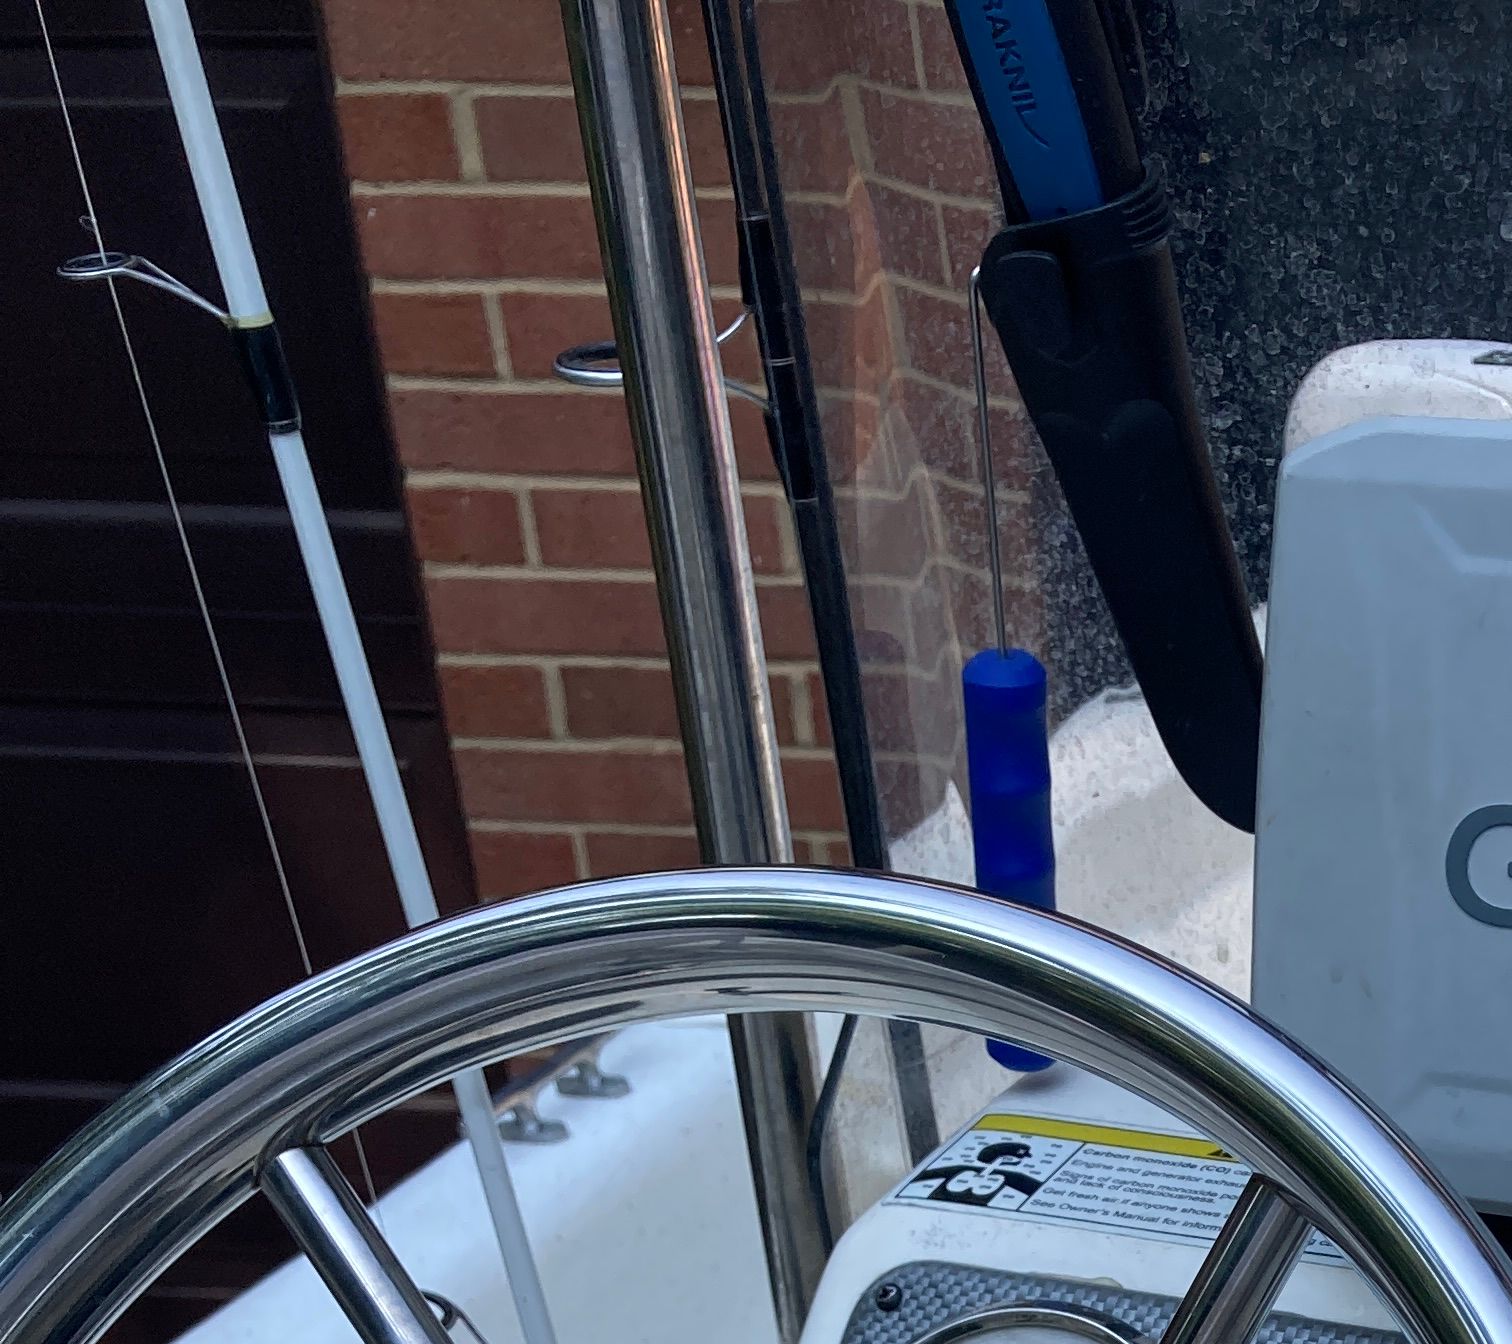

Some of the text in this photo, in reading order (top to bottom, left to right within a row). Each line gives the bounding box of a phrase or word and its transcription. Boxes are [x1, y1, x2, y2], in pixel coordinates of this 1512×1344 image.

[1083, 1148, 1130, 1160] Carbon
[1133, 1156, 1198, 1169] monoxide
[1200, 1164, 1232, 1175] (CO)
[1067, 1191, 1099, 1200] fresh
[1030, 1199, 1056, 1208] See
[1113, 1210, 1161, 1223] Manual
[1162, 1218, 1180, 1226] for
